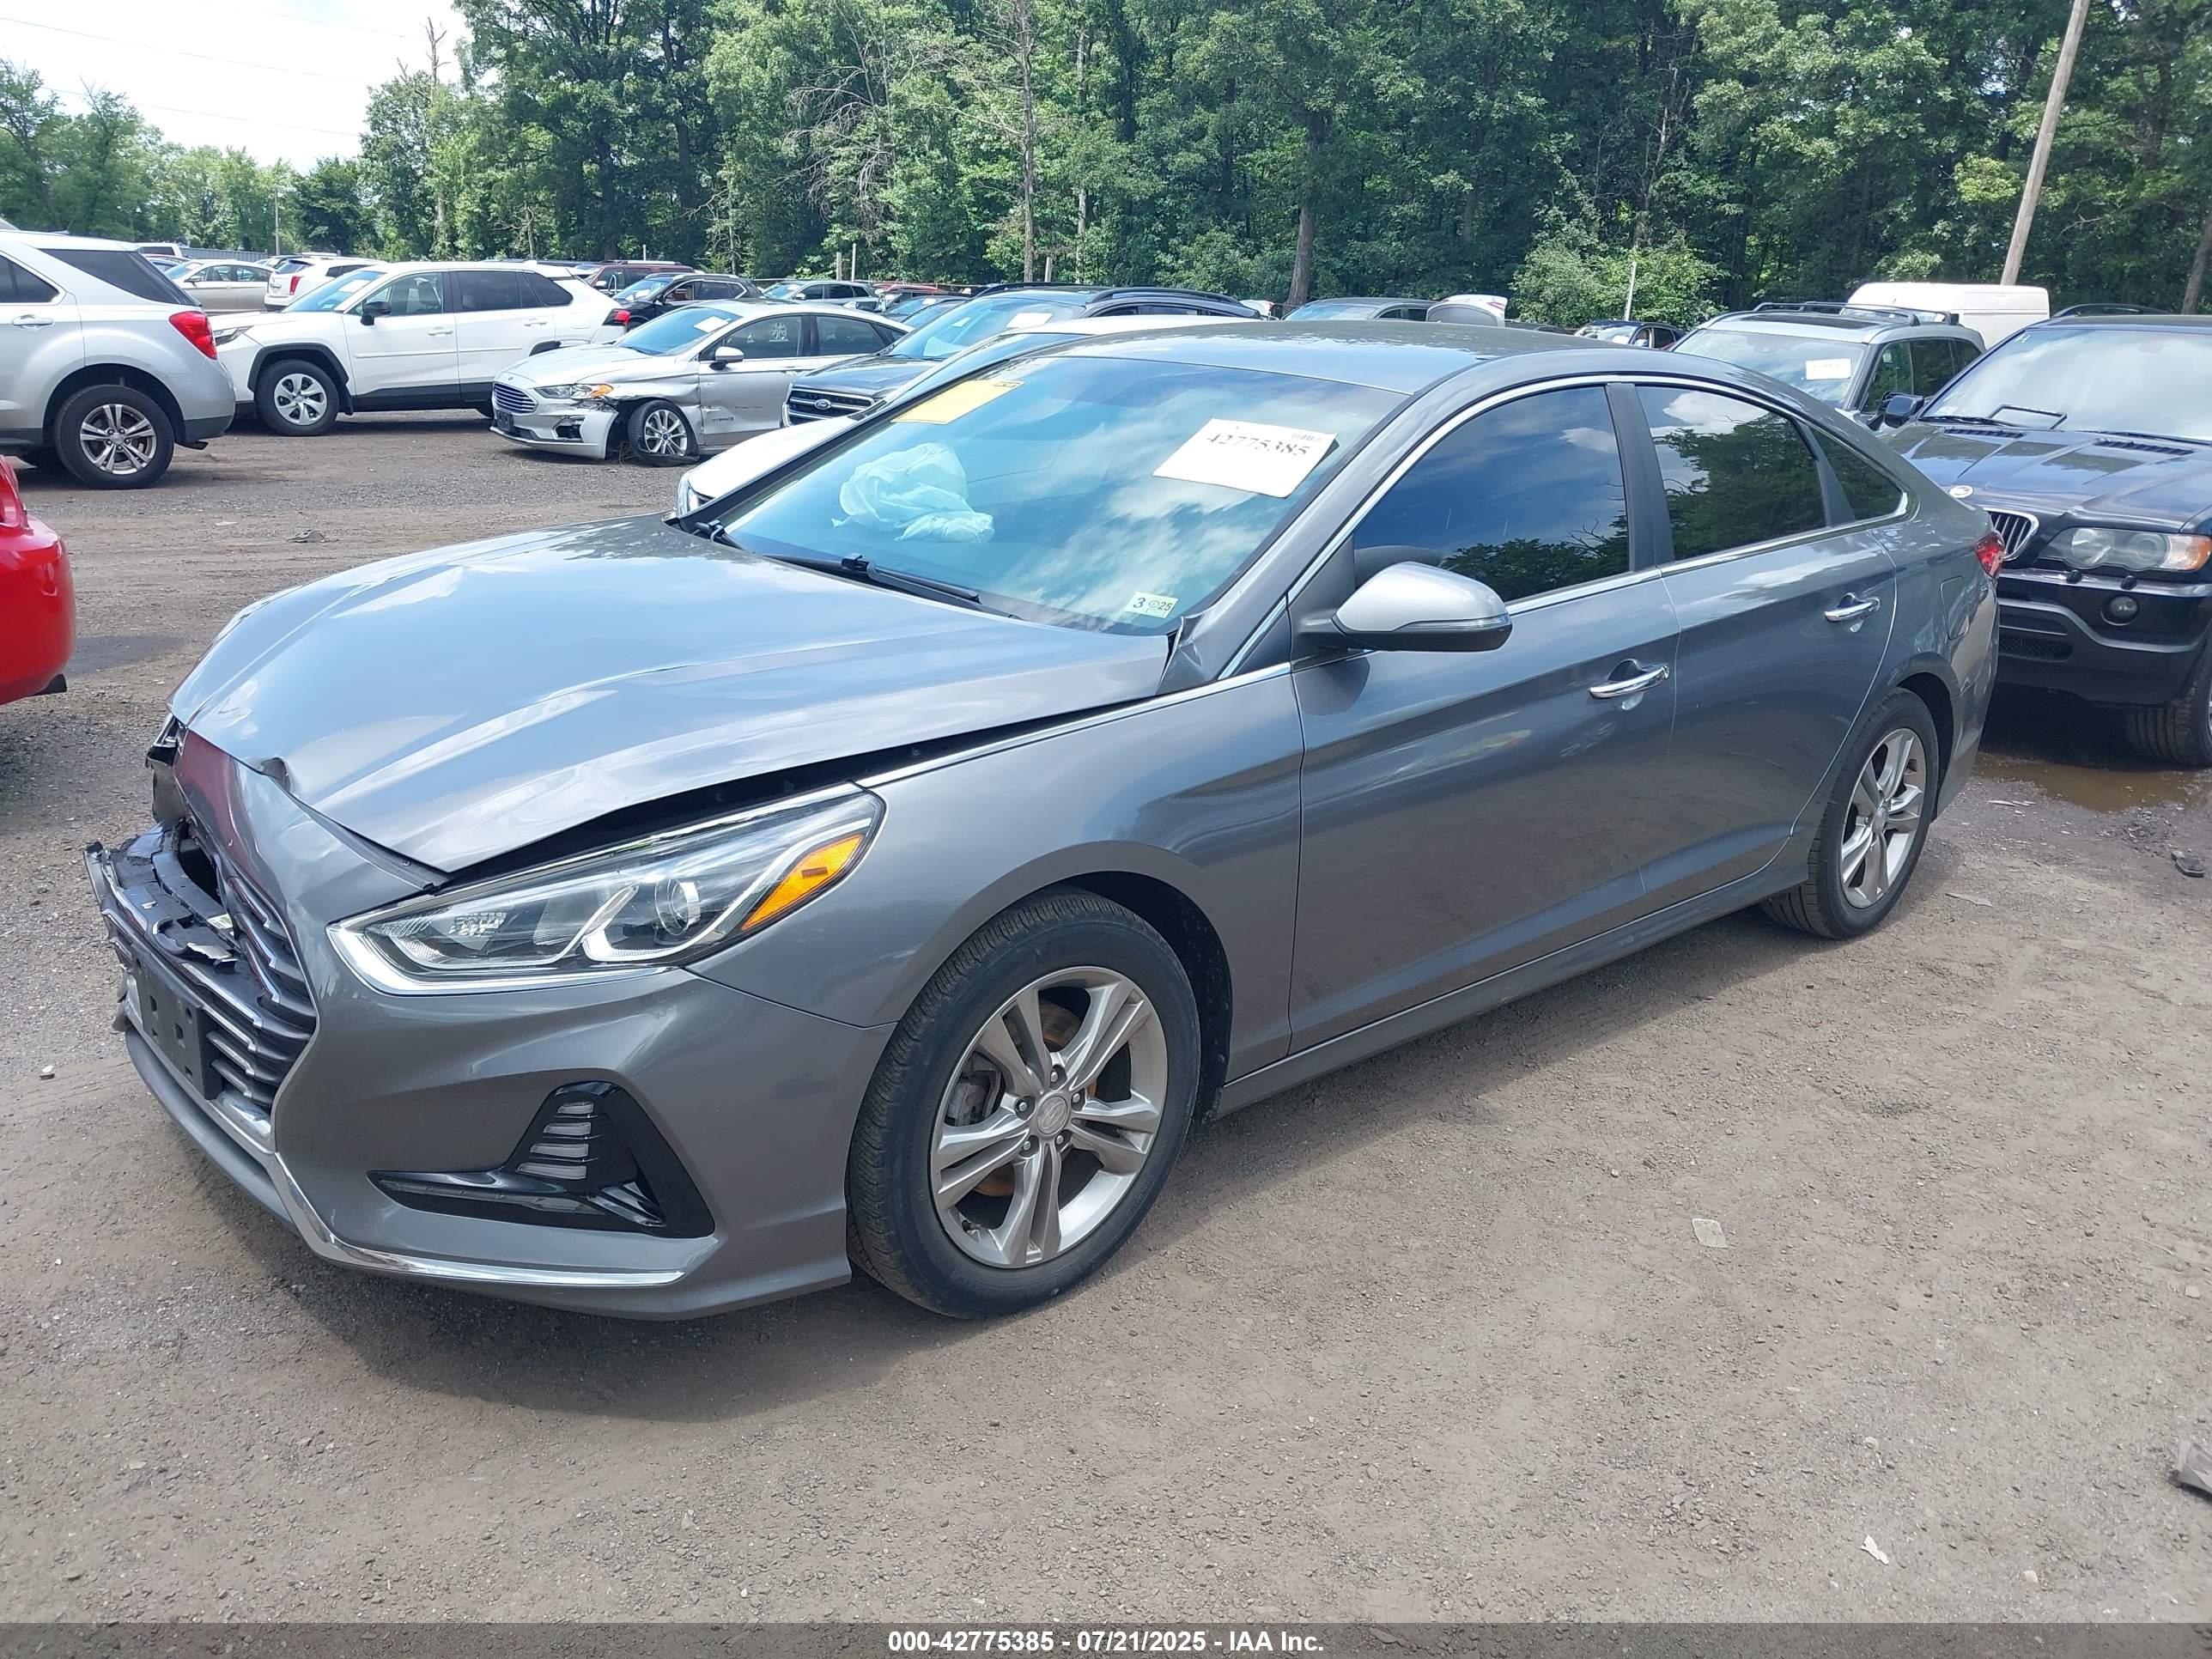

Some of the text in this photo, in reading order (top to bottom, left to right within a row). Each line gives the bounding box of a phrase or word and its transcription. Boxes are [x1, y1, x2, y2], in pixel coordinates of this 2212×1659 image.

[1206, 433, 1311, 457] 42775385
[1133, 597, 1174, 611] 3 25
